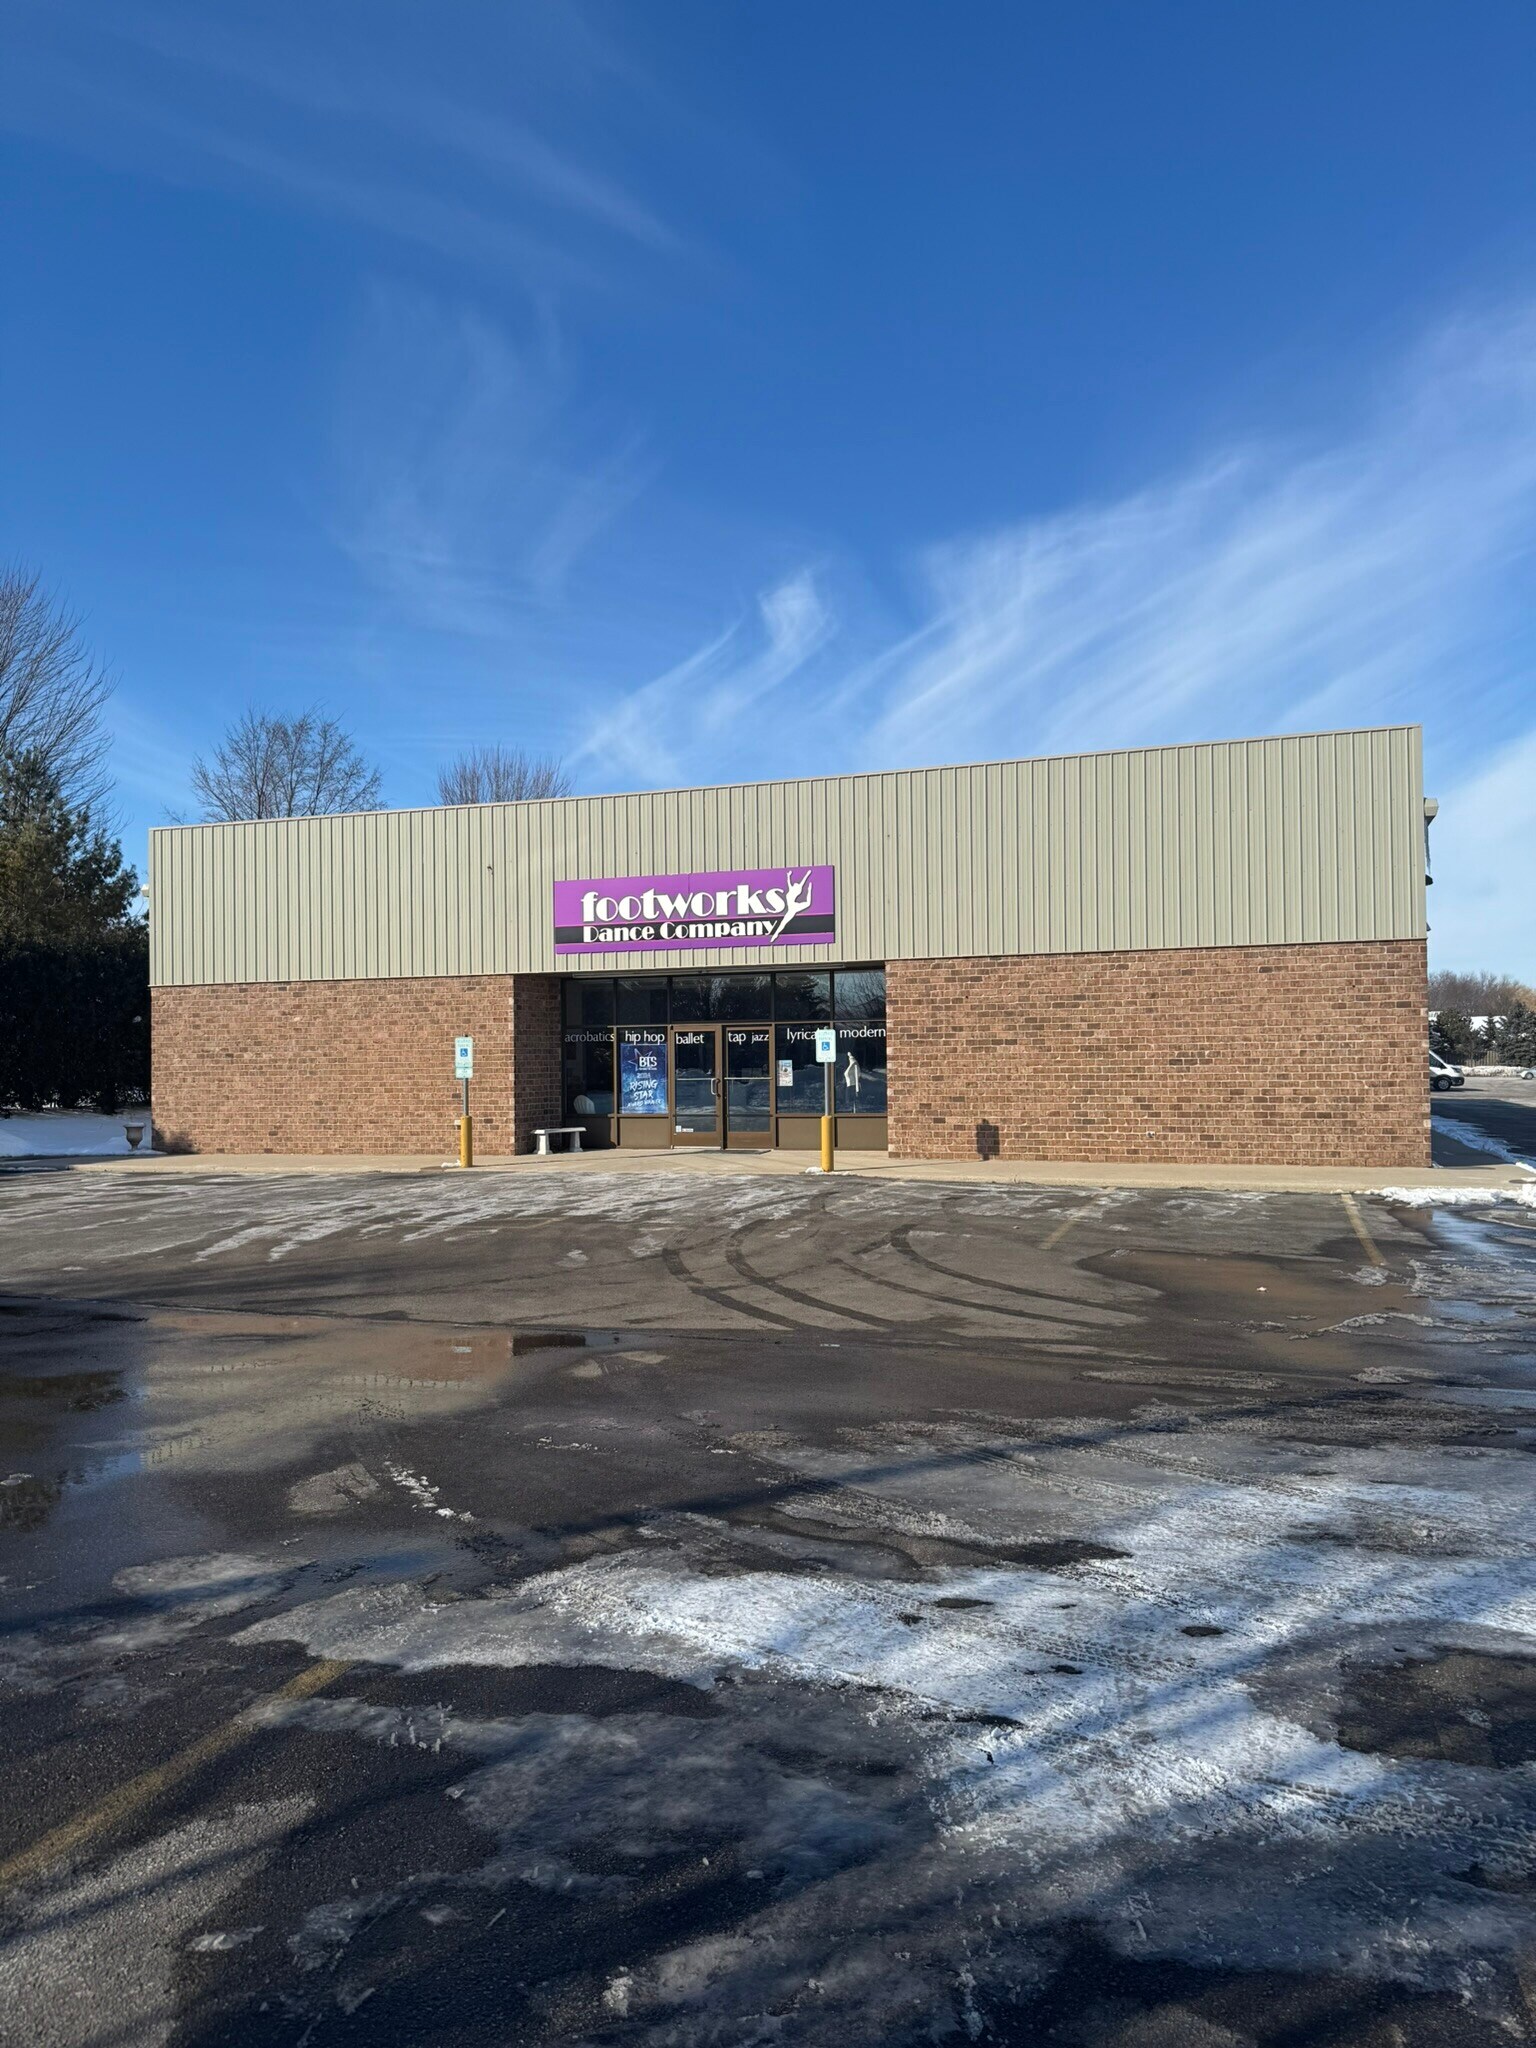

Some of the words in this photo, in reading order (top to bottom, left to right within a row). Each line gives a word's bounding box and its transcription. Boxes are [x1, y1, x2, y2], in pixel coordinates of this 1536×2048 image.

[581, 885, 784, 922] footworks
[583, 925, 655, 943] Dance
[660, 919, 778, 939] Company
[564, 1031, 615, 1042] acrobatics
[625, 1030, 641, 1045] hip
[644, 1030, 665, 1045] hop
[676, 1032, 704, 1044] ballet
[728, 1032, 747, 1045] tap
[751, 1032, 769, 1044] jazz
[787, 1028, 819, 1043] lyrica
[839, 1026, 886, 1039] modern
[639, 1056, 658, 1067] BTS
[630, 1079, 658, 1091] RISING
[633, 1090, 654, 1100] STAR
